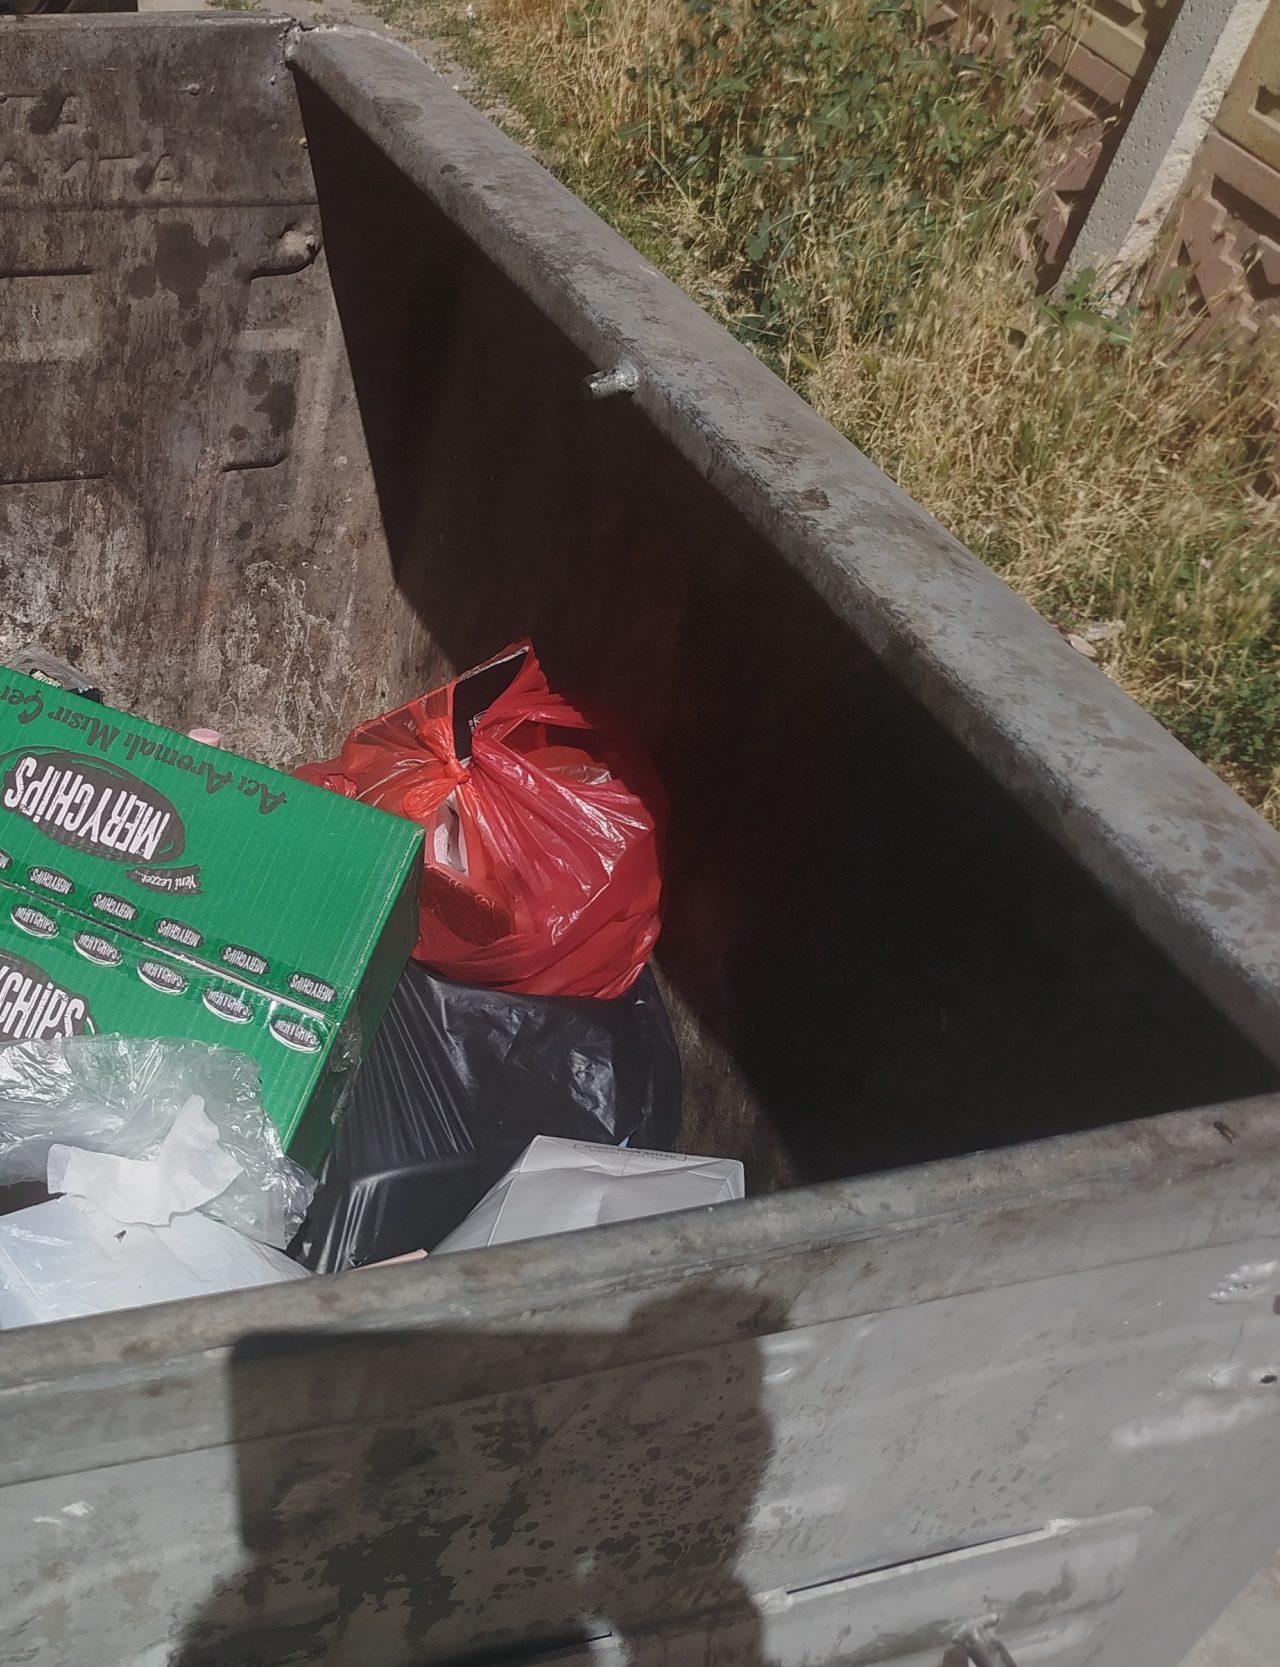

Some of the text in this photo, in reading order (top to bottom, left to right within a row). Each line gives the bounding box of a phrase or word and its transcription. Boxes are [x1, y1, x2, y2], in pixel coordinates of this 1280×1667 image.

[47, 706, 120, 752] Mısır
[122, 732, 234, 795] Aromalı
[235, 775, 288, 815] Acı
[175, 874, 197, 891] Yeni
